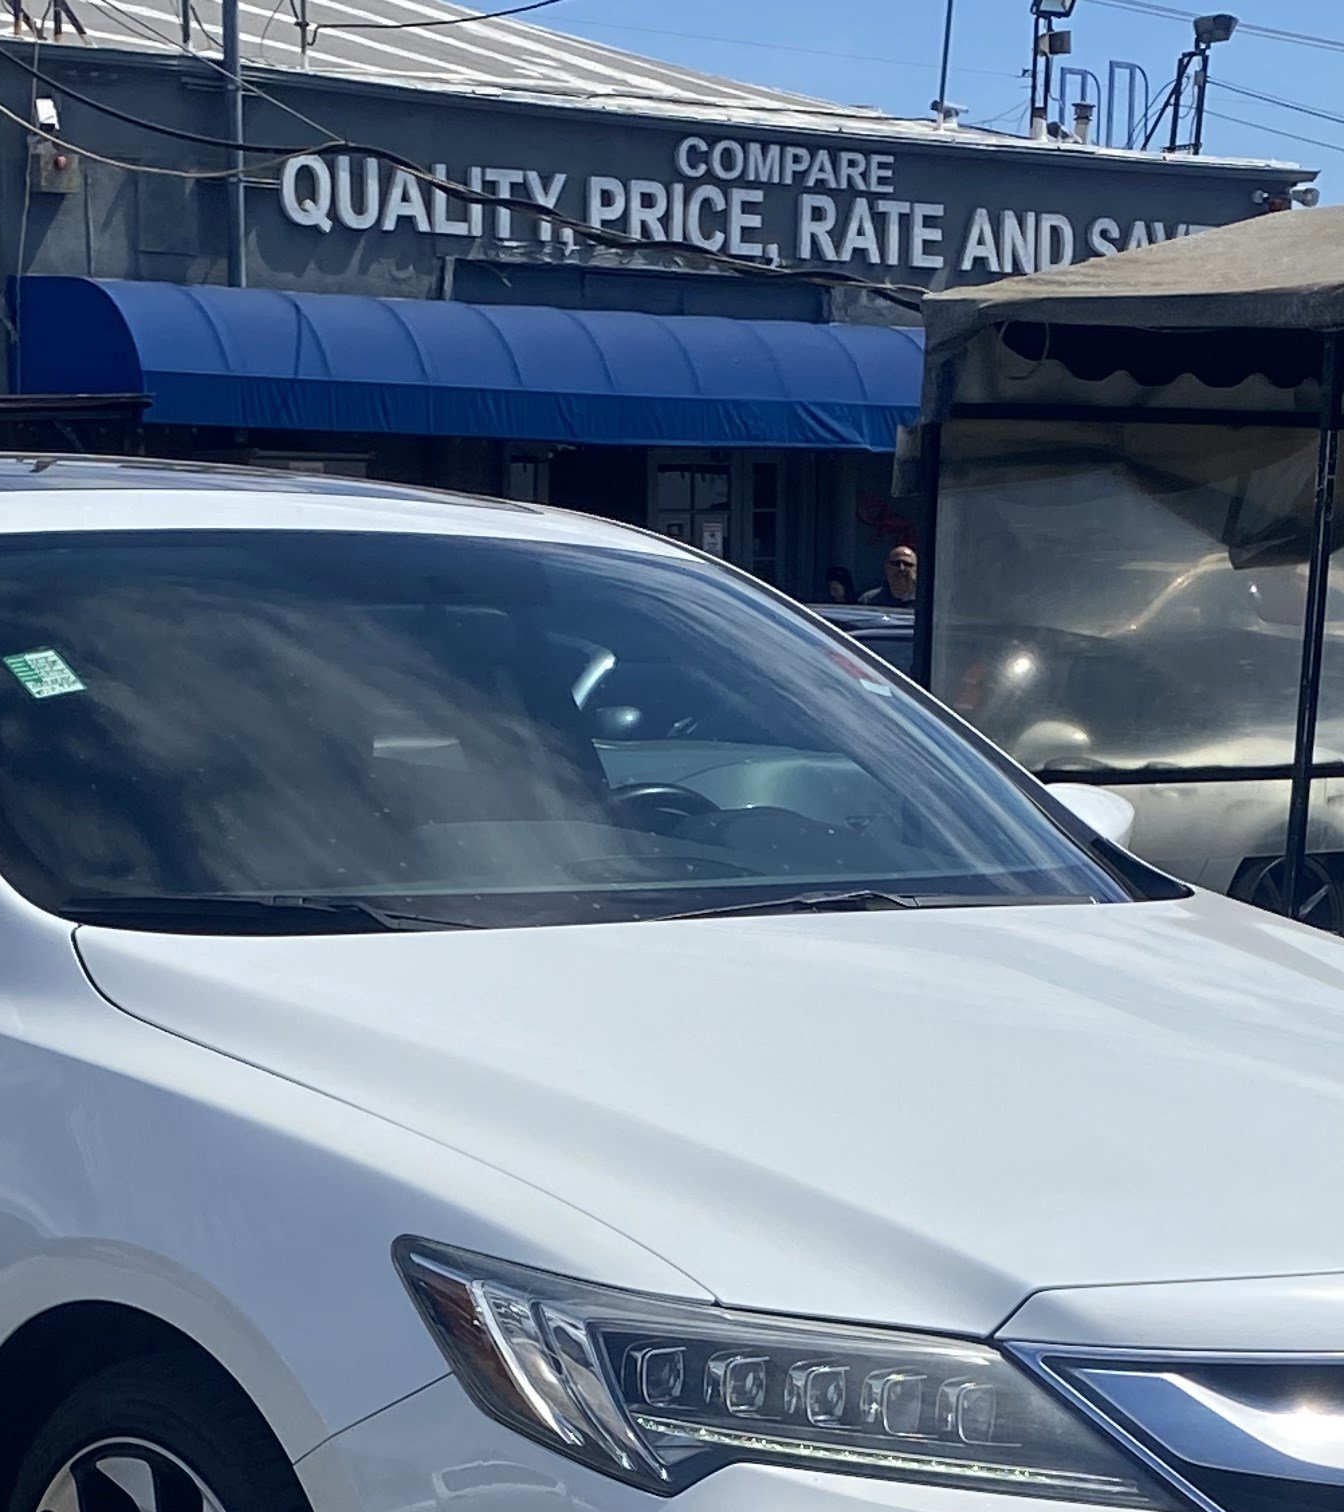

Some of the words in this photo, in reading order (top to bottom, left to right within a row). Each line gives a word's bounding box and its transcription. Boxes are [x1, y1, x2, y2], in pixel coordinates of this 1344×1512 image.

[676, 136, 895, 193] COMPARE
[280, 154, 574, 256] QUALITY,
[587, 176, 779, 268] PRICE,
[797, 193, 945, 270] RATE
[960, 207, 1074, 275] AND
